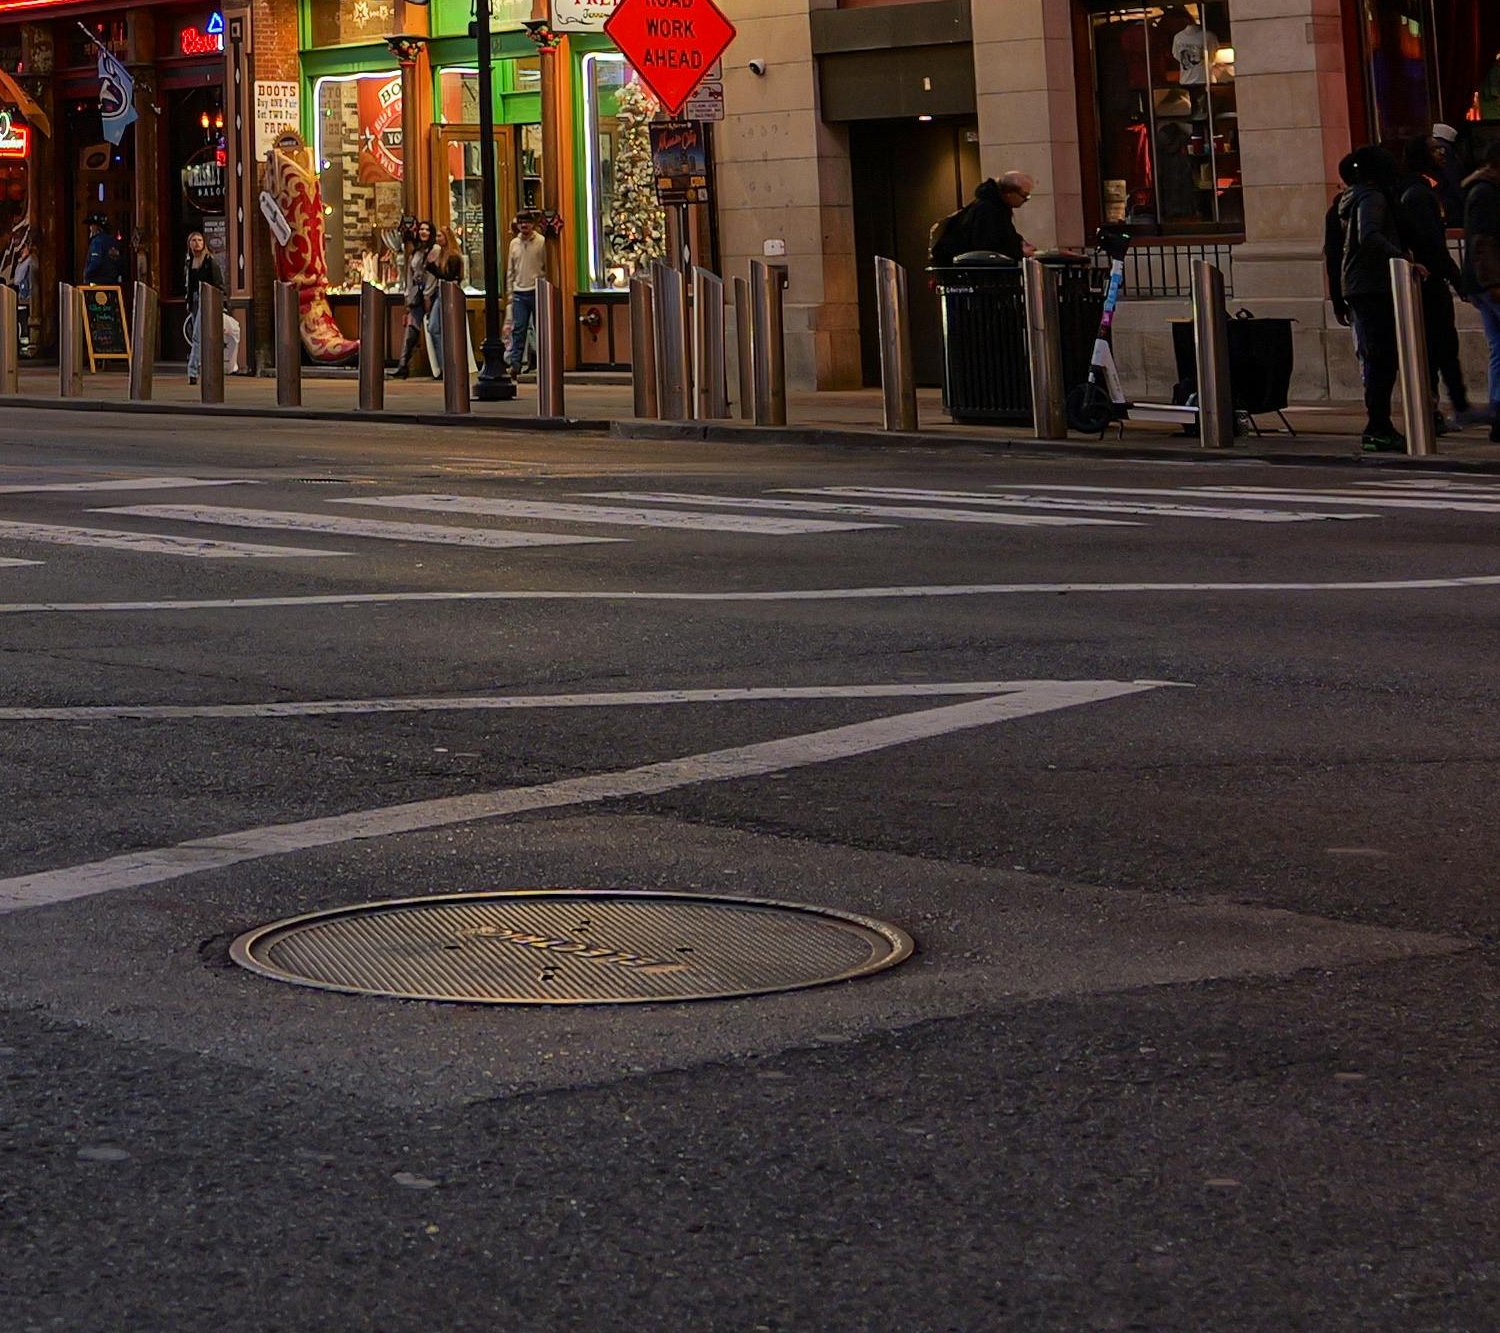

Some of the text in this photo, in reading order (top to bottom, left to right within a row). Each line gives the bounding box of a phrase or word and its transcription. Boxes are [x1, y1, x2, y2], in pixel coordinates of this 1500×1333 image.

[646, 19, 696, 38] WORK
[643, 48, 703, 69] AHEAD
[257, 85, 297, 97] BOOTS
[380, 82, 402, 105] BO
[257, 99, 269, 109] Buy
[284, 100, 298, 108] Pair
[257, 110, 298, 120] Get TWO Pair
[387, 133, 402, 146] YO
[375, 148, 396, 173] TWO
